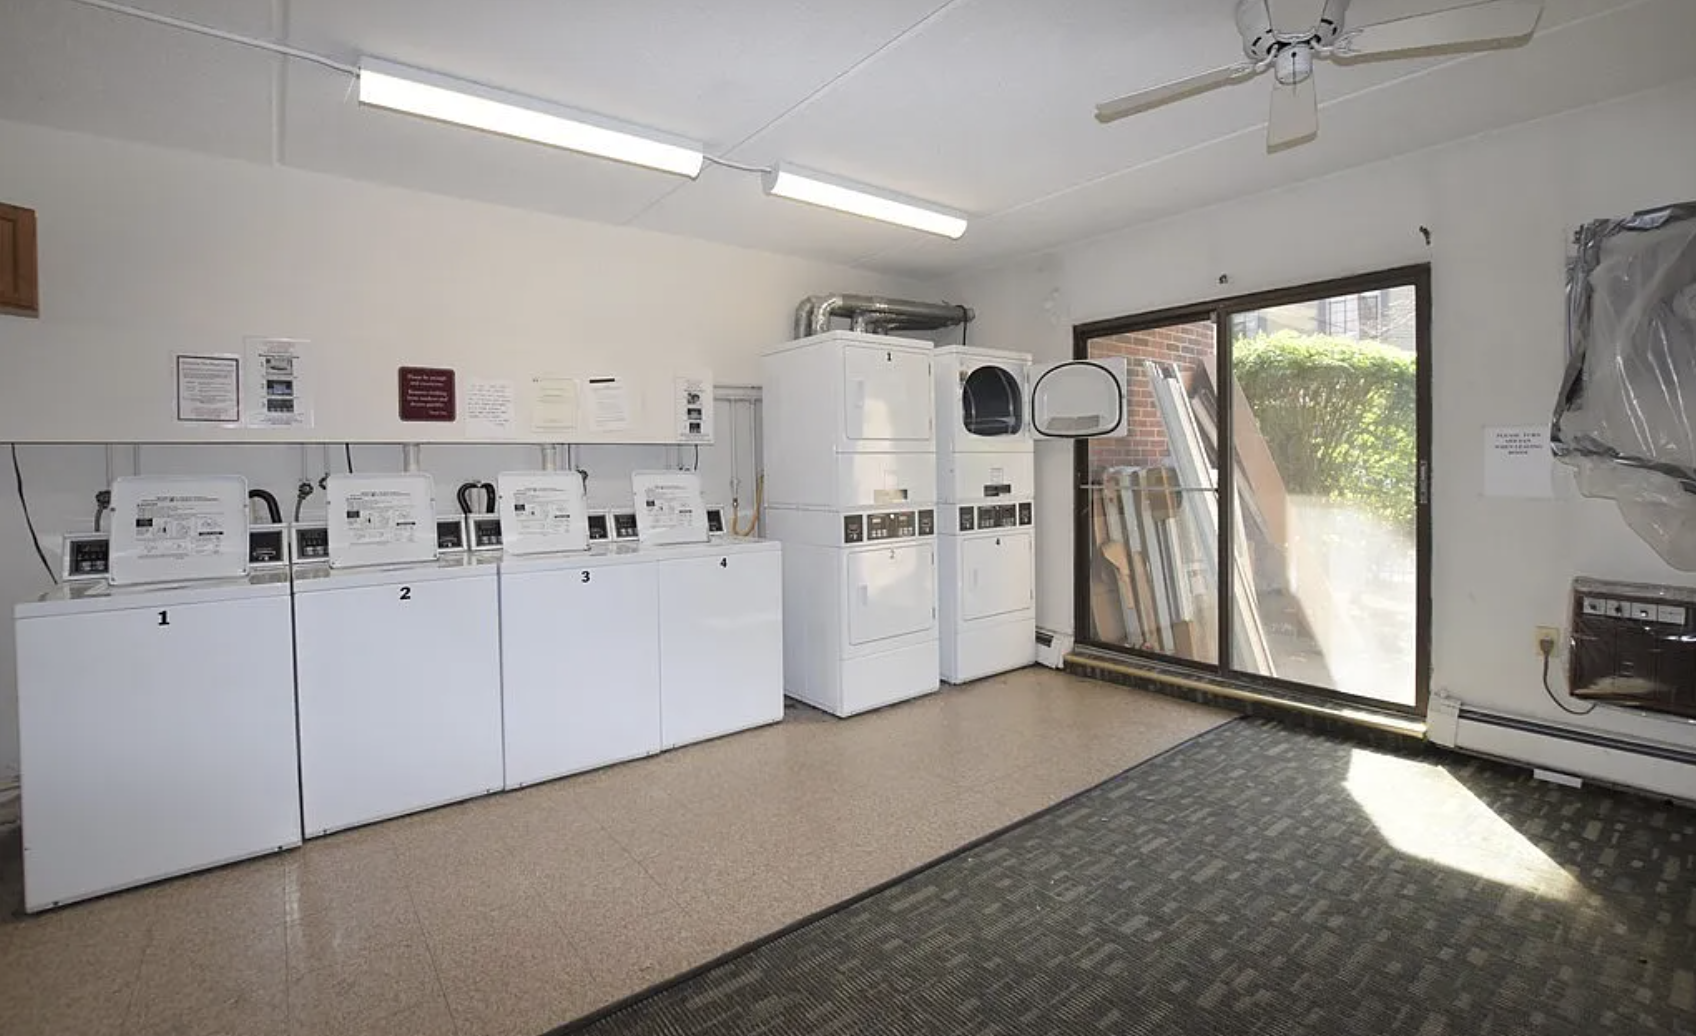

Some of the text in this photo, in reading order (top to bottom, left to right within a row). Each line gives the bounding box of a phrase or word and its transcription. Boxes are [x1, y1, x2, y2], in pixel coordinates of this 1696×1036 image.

[719, 557, 727, 568] 4
[581, 571, 591, 584] 3
[399, 586, 411, 601] 2
[158, 610, 170, 626] 1
